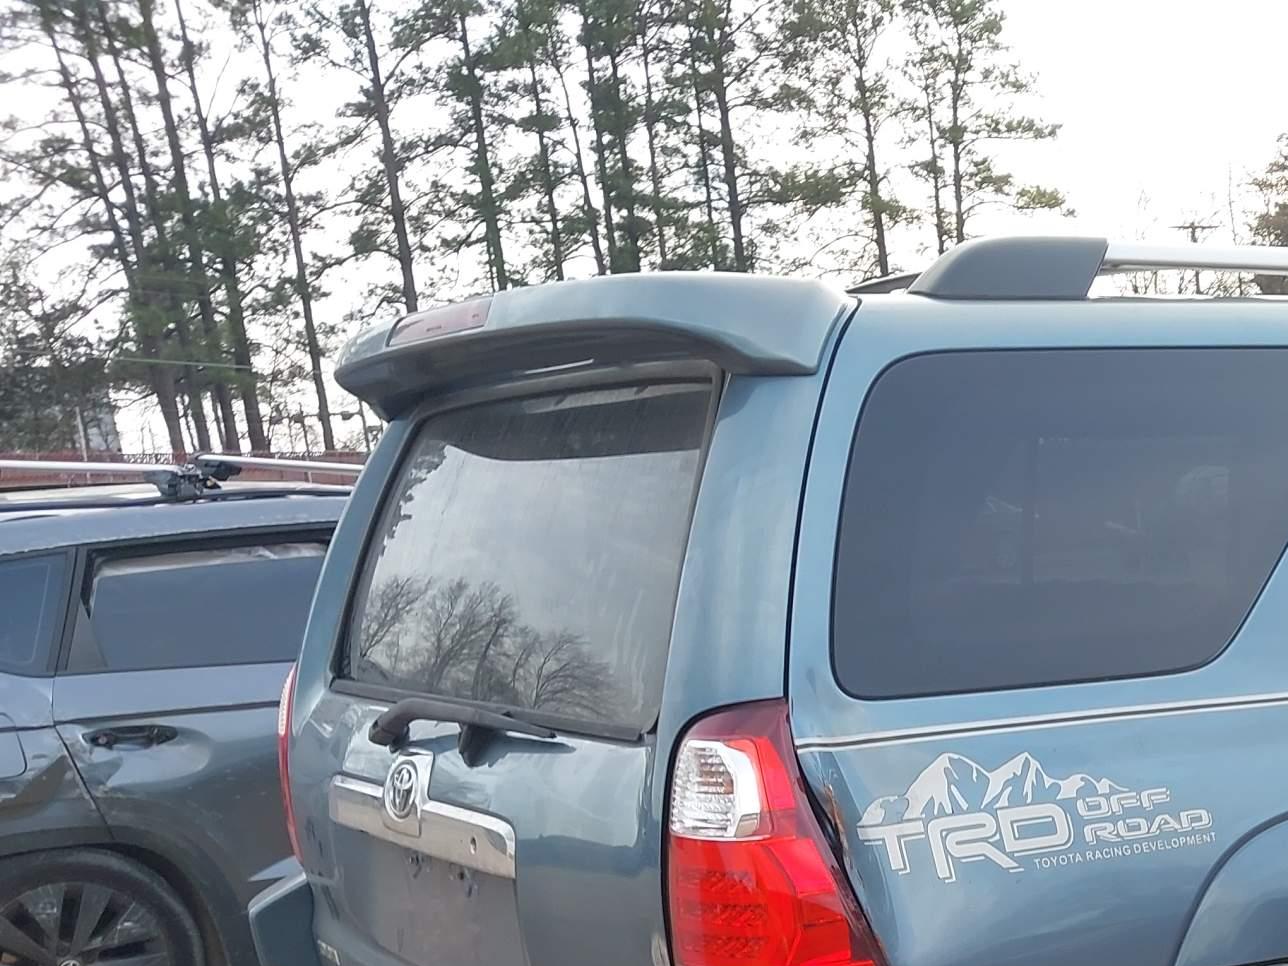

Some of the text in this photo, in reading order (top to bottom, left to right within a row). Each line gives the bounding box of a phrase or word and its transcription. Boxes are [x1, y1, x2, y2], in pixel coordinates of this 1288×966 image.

[1076, 787, 1170, 819] OFF
[857, 802, 1074, 883] TRD
[1083, 808, 1212, 846] ROAD
[1034, 831, 1217, 870] TOYOTA RACING DEVELOPMENT
